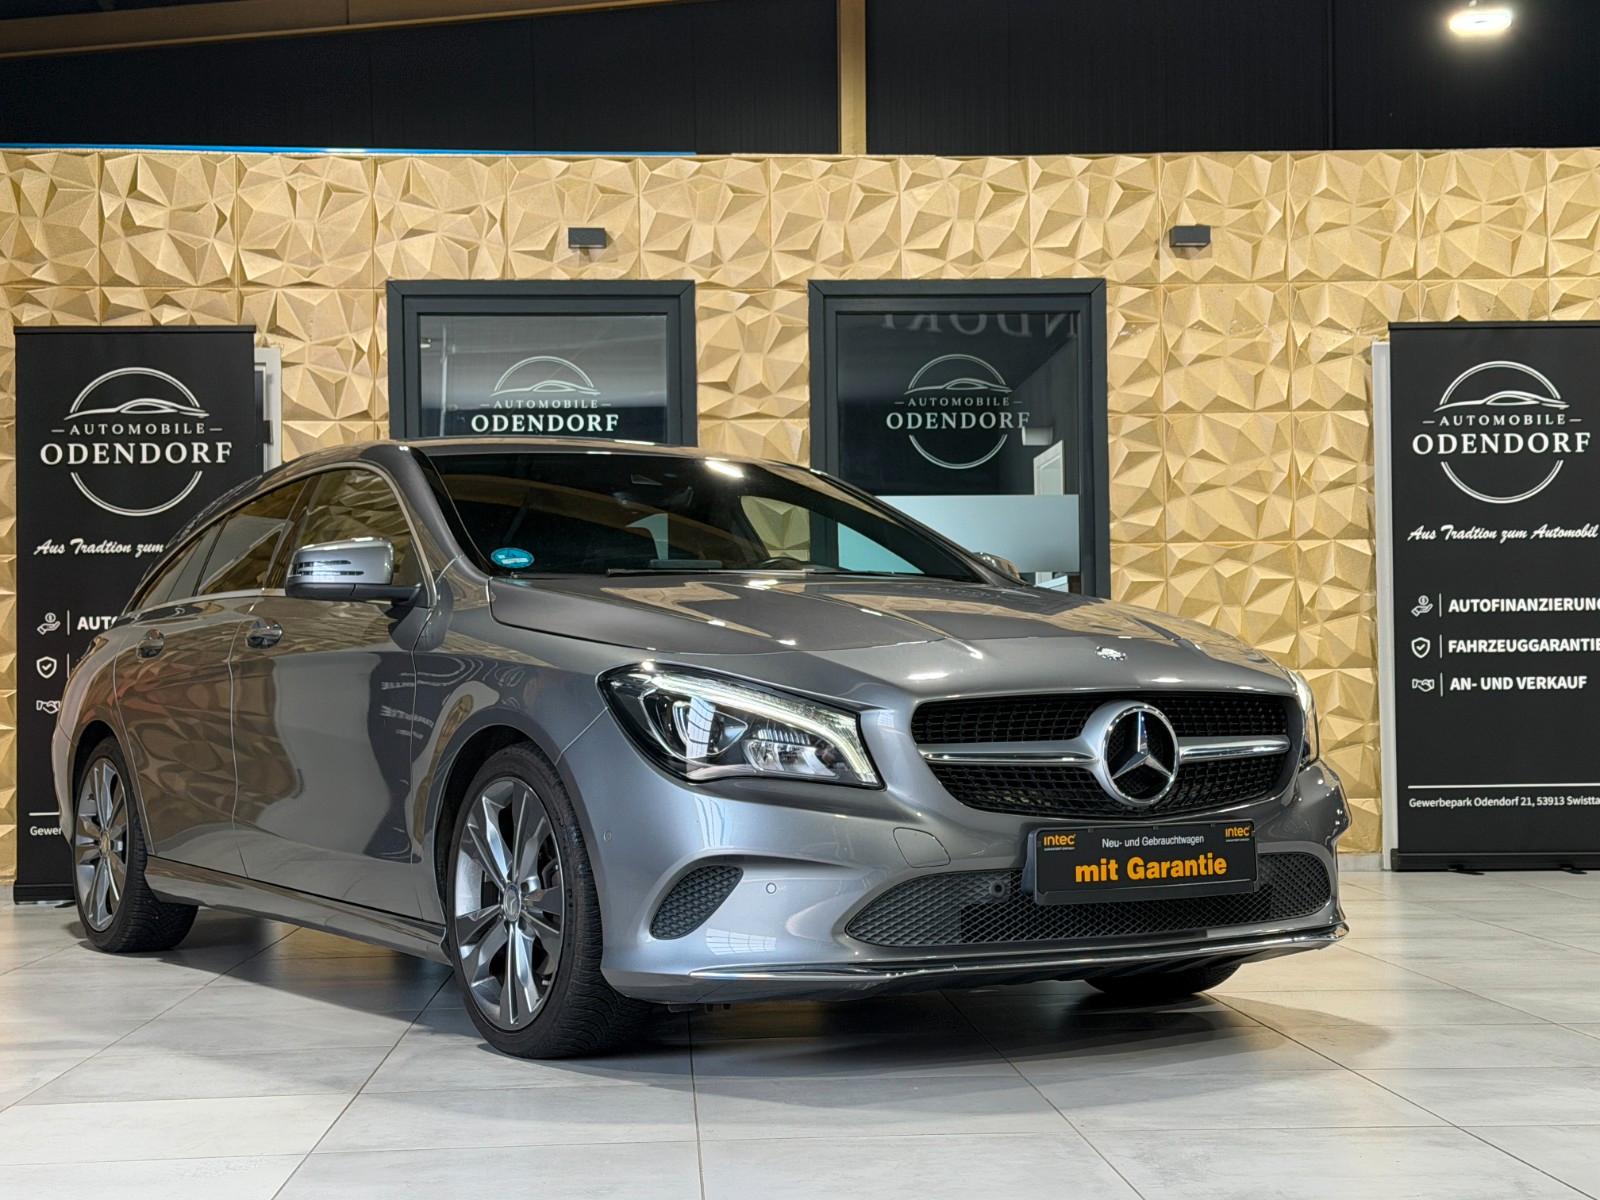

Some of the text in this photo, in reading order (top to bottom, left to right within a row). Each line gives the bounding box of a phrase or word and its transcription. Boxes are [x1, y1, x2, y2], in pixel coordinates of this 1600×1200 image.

[493, 398, 599, 410] AUTOMOBILE
[906, 396, 1010, 407] AUTOMOBILE
[470, 413, 619, 433] ODENDORF
[885, 411, 1031, 432] ODENDORF
[1439, 413, 1566, 427] AUTOMOBILE
[69, 422, 205, 436] AUTOMOBILE
[1412, 431, 1591, 455] ODENDORF
[40, 441, 233, 465] ODENDORF
[1407, 525, 1437, 541] Aus
[1499, 529, 1528, 544] zum
[1530, 522, 1600, 540] Automobil
[33, 538, 66, 556] Aus
[134, 542, 165, 559] zum
[1448, 597, 1600, 613] AUTOFINANZIERUN
[1449, 675, 1588, 691] AN- UND VERKAUF
[1408, 796, 1473, 810] Gewerbepark
[1473, 795, 1520, 807] Odendorf
[1520, 796, 1536, 808] 21,
[1536, 795, 1566, 807] 53913
[1043, 834, 1076, 846] intec
[1101, 833, 1205, 849] Neu- und Gebrauchtwagen
[1075, 852, 1228, 883] mit Garantie
